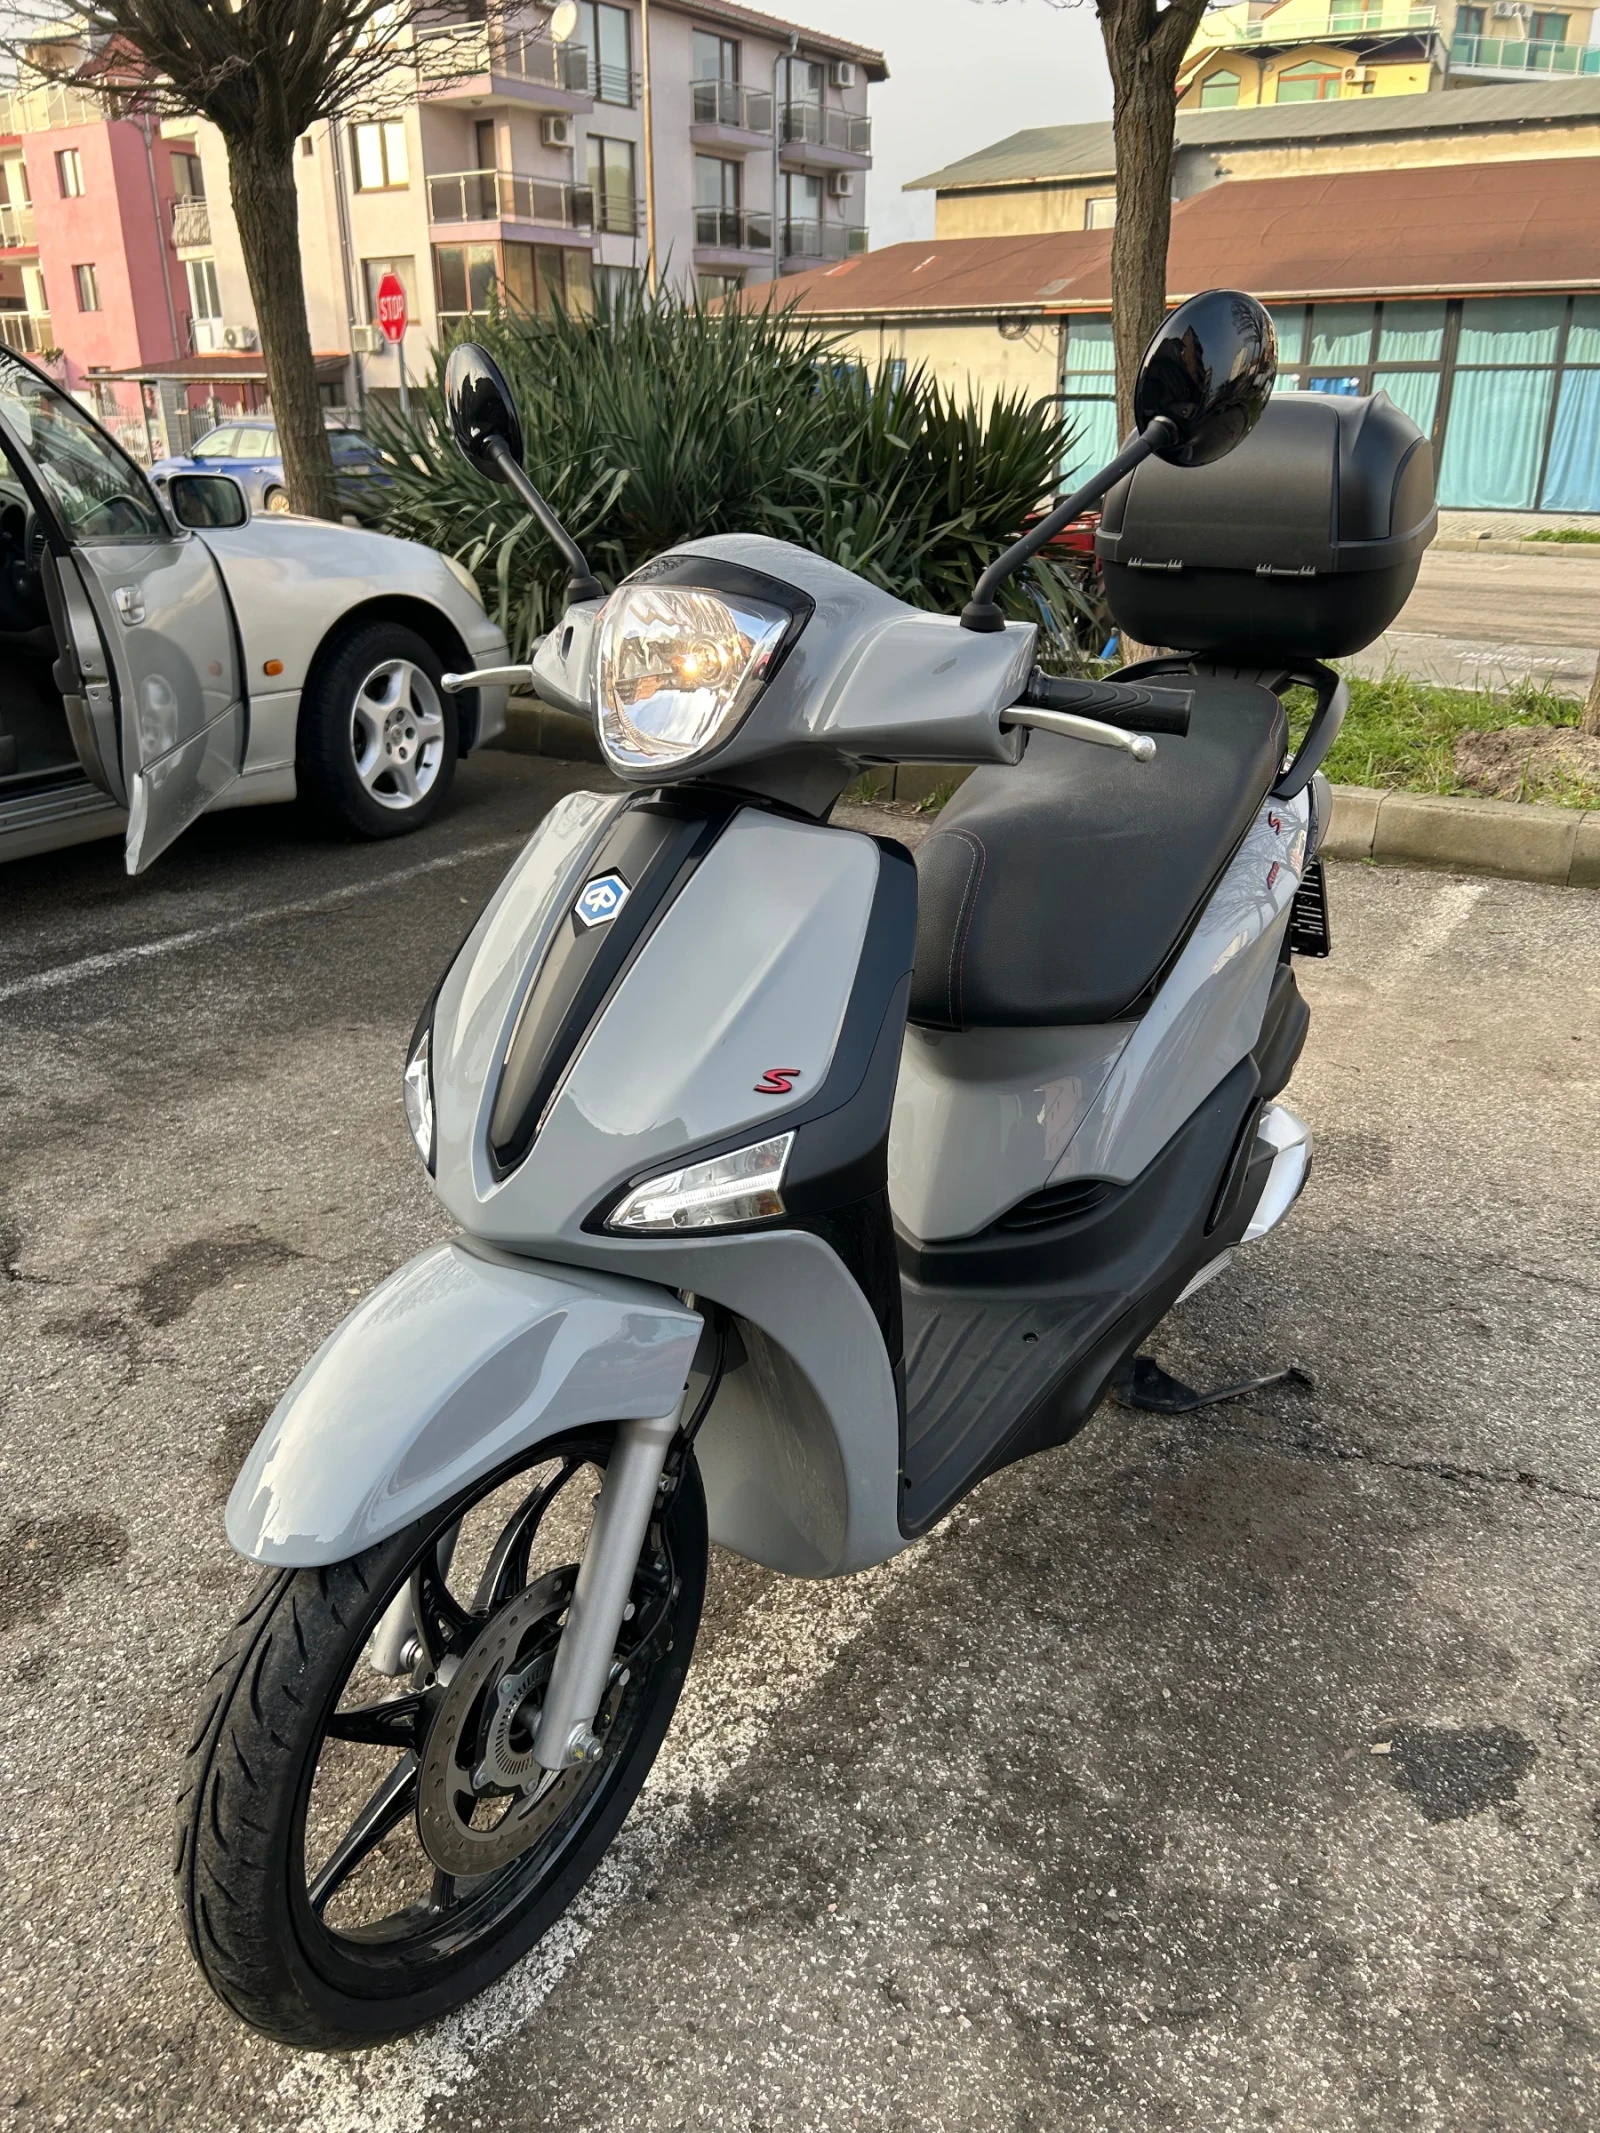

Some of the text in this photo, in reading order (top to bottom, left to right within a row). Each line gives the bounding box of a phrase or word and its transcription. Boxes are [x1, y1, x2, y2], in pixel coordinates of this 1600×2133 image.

[380, 295, 404, 321] STOP
[1268, 811, 1281, 835] S
[753, 1068, 801, 1094] S
